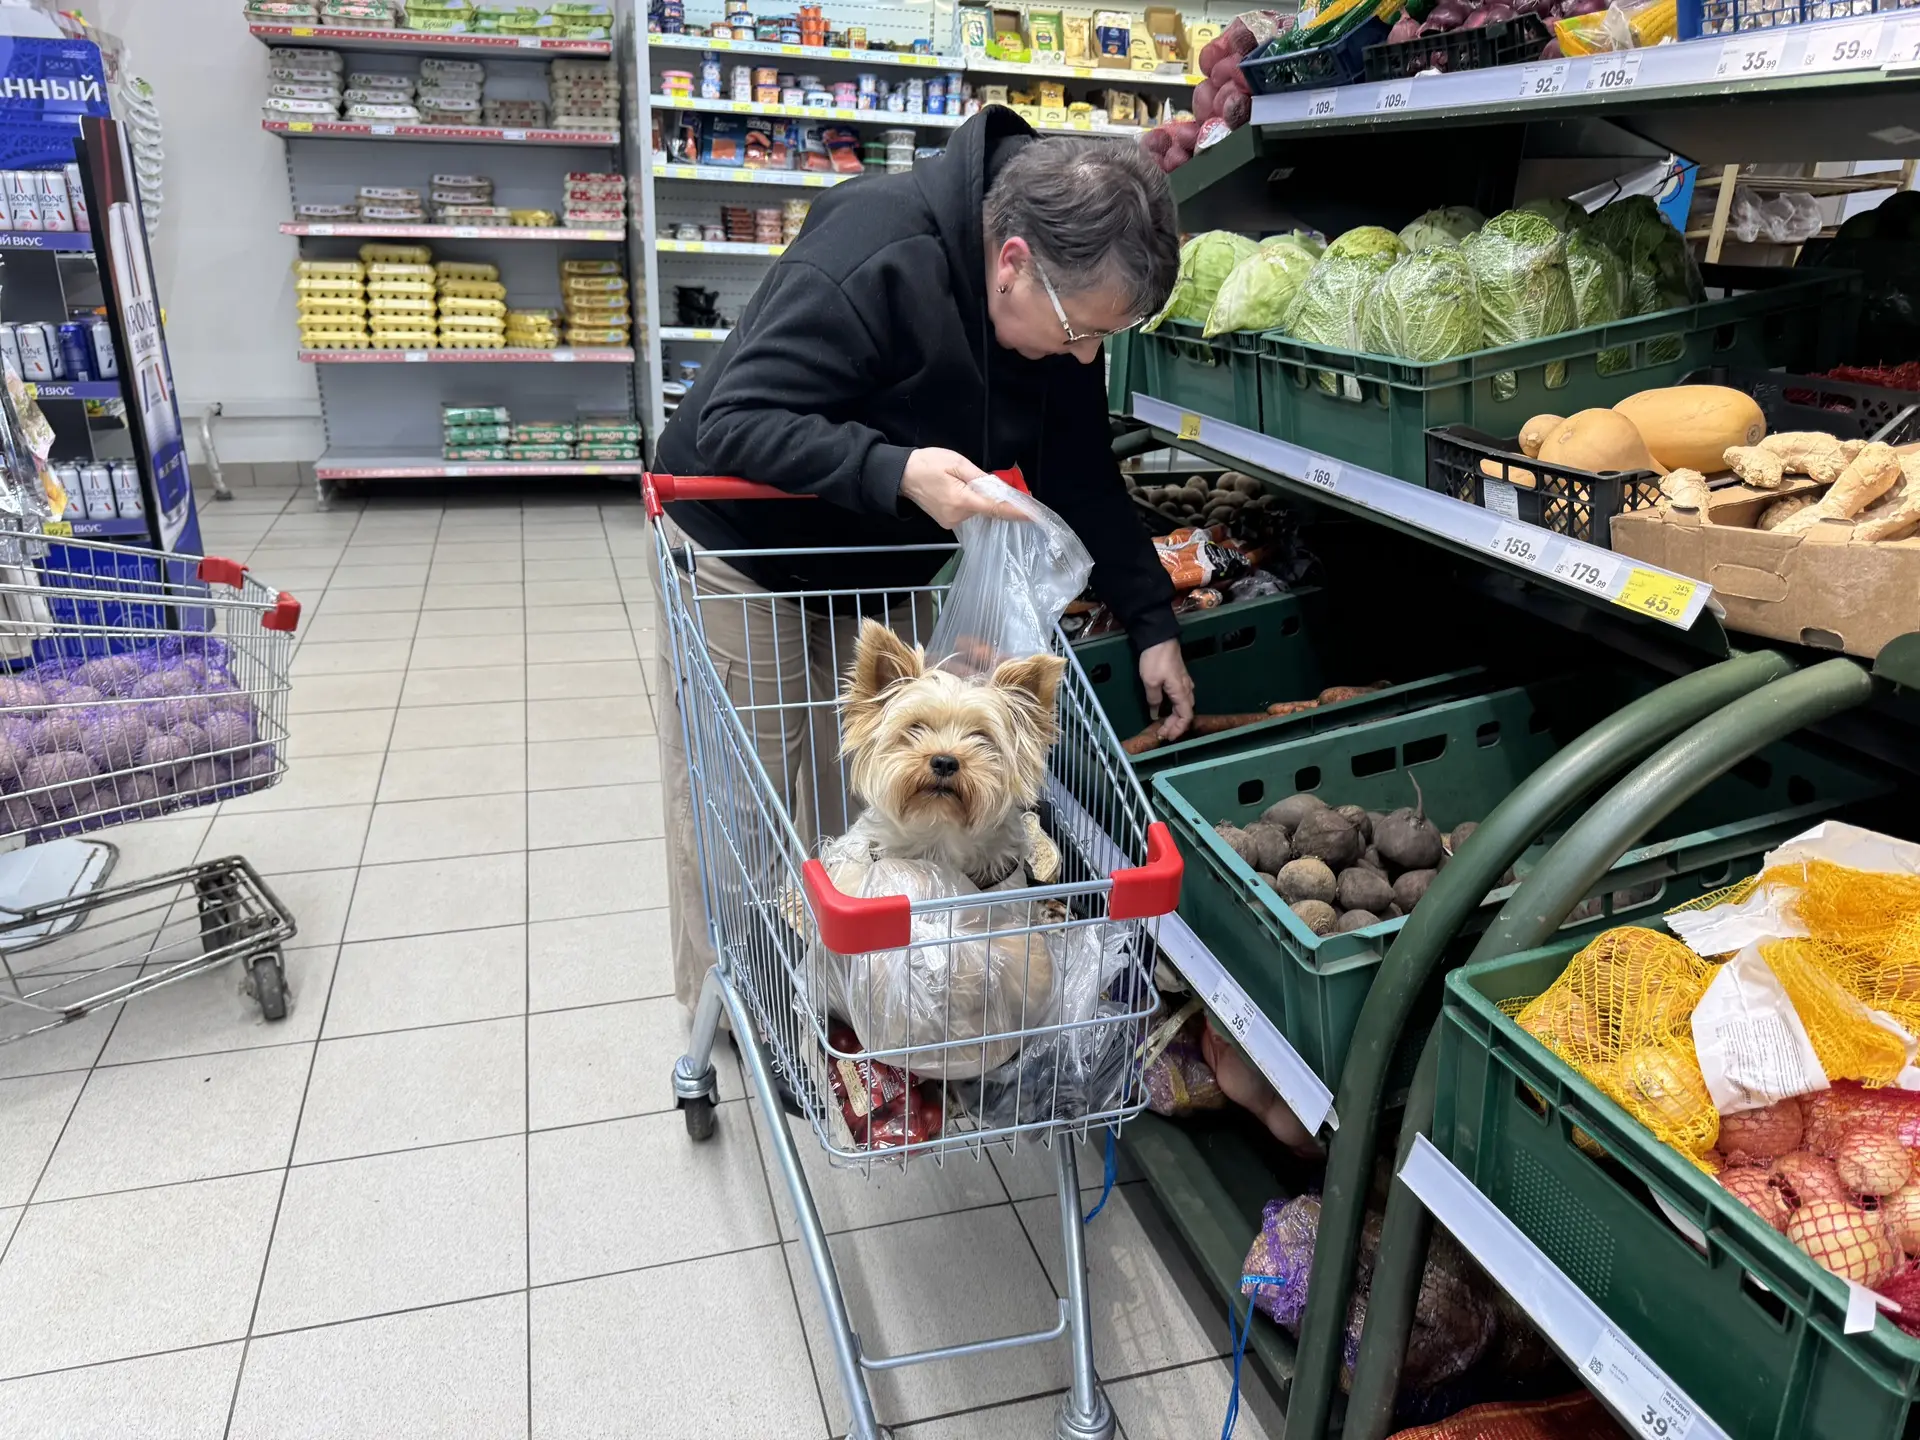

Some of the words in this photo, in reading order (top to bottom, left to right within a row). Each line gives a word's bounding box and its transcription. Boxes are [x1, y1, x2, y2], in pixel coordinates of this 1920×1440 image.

[1832, 39, 1873, 62] 59.99
[1742, 50, 1777, 71] 35.99
[1535, 77, 1559, 93] 92.99
[12, 236, 43, 246] ВКУС
[45, 386, 75, 396] ВКУС
[74, 524, 102, 533] ВКУС
[1503, 537, 1537, 561] 159.99
[1570, 562, 1607, 589] 179.99
